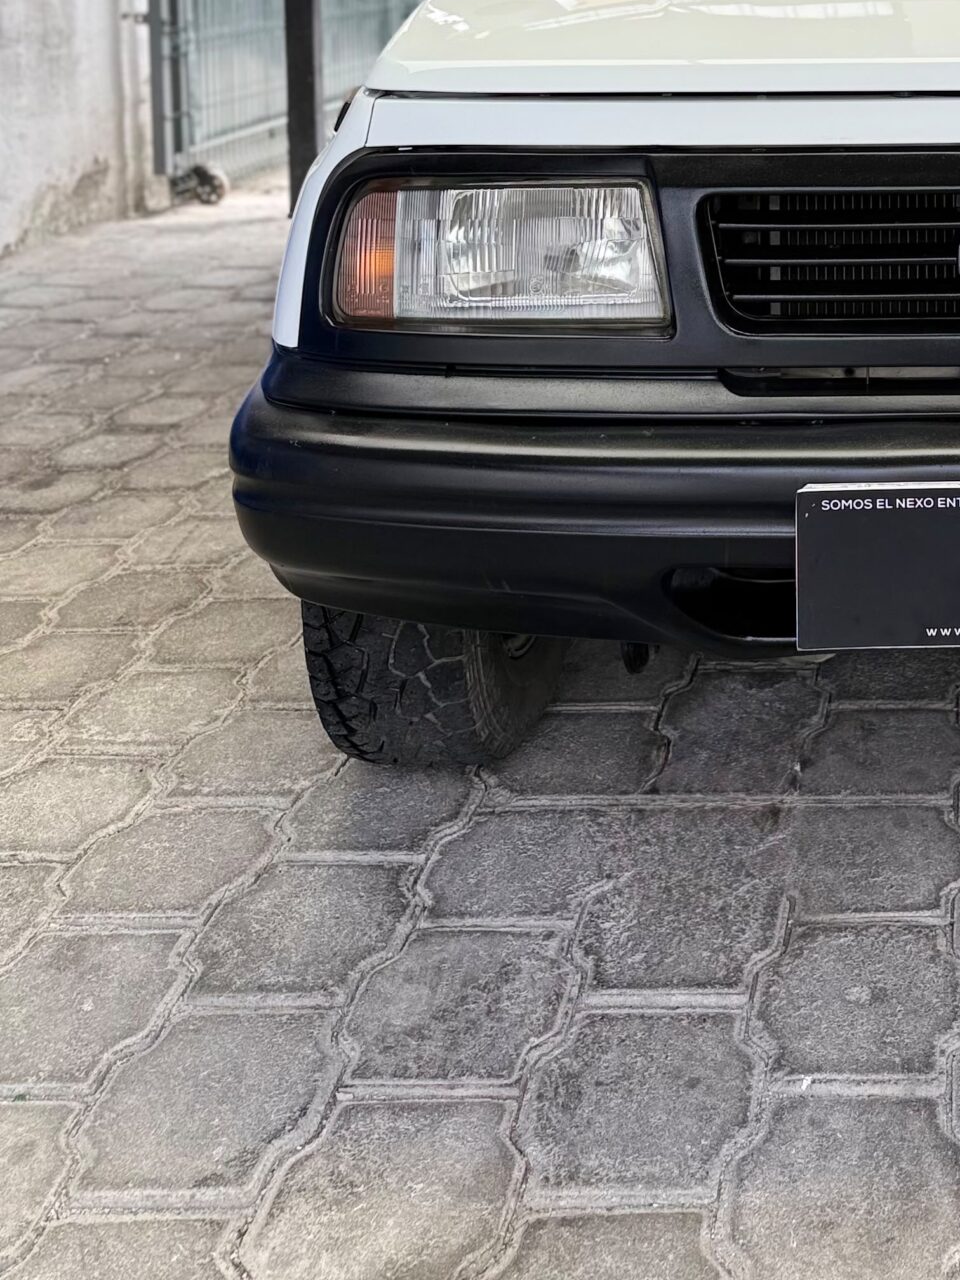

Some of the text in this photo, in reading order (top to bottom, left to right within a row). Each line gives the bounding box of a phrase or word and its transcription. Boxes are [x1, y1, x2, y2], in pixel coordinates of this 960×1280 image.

[821, 498, 873, 511] SOMOS
[876, 498, 893, 509] EL
[896, 497, 934, 508] NEXO
